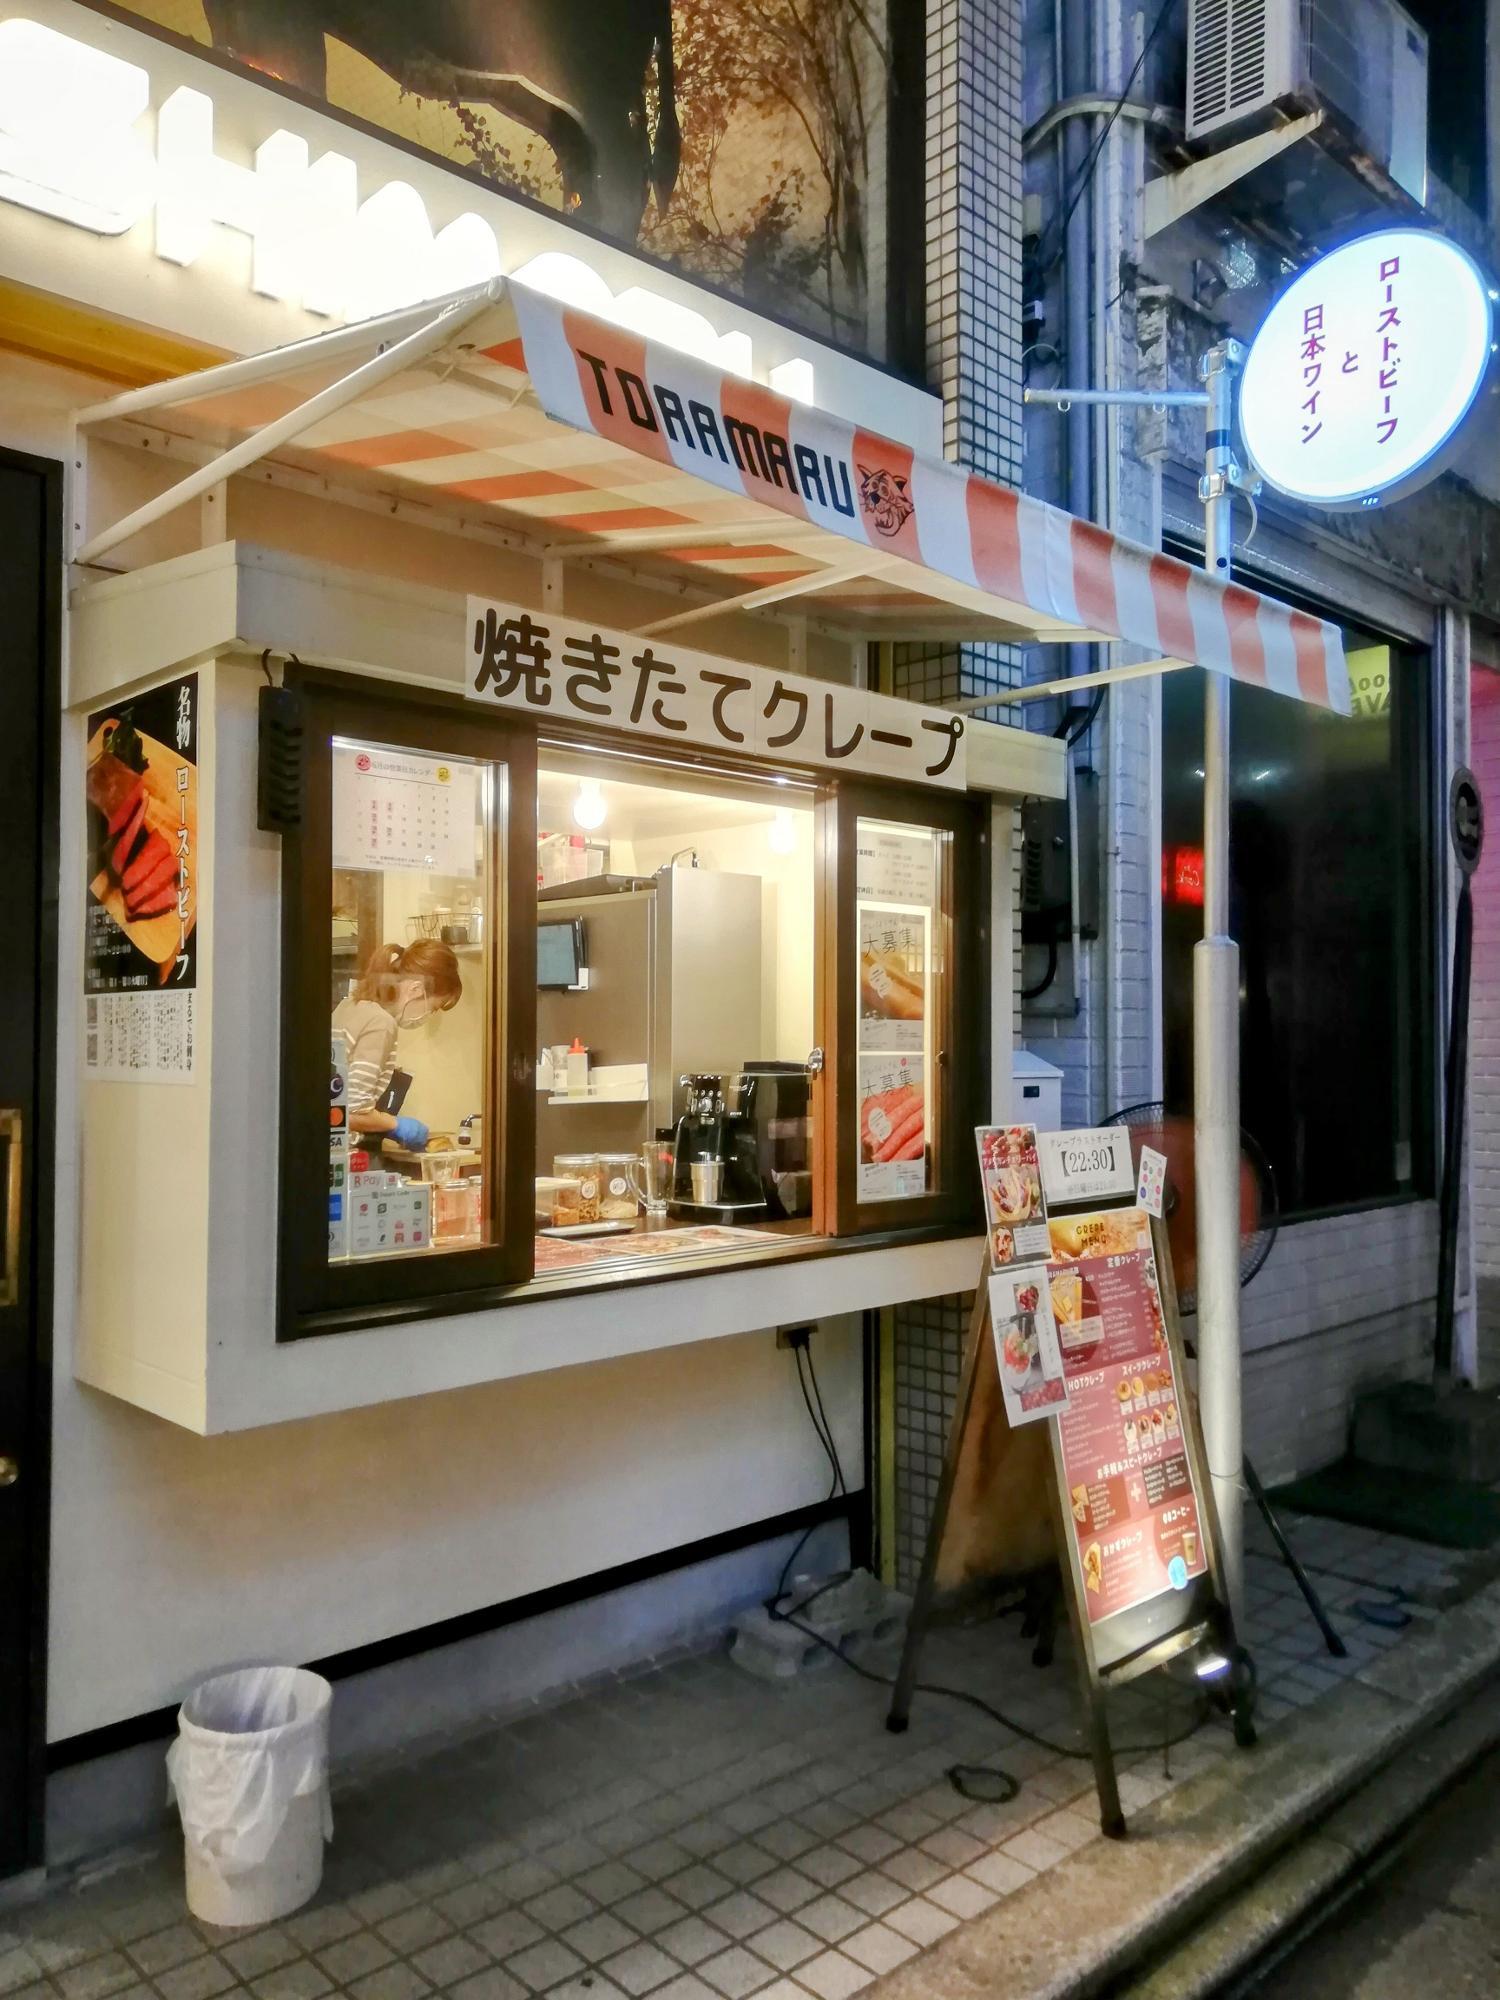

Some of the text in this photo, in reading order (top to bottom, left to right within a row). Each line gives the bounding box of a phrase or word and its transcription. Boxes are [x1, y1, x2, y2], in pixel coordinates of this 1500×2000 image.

[1301, 304, 1327, 444] 日本ワイン
[1342, 351, 1359, 374] と
[1376, 256, 1402, 445] ローストビーフ
[576, 348, 856, 519] TORAMARU
[473, 606, 968, 778] 焼きたてクレープ
[175, 685, 191, 981] 名物 ローストビーフ
[863, 928, 915, 958] 大募集
[862, 1069, 914, 1102] 大募集
[1068, 1372, 1105, 1392] HOTクレープ
